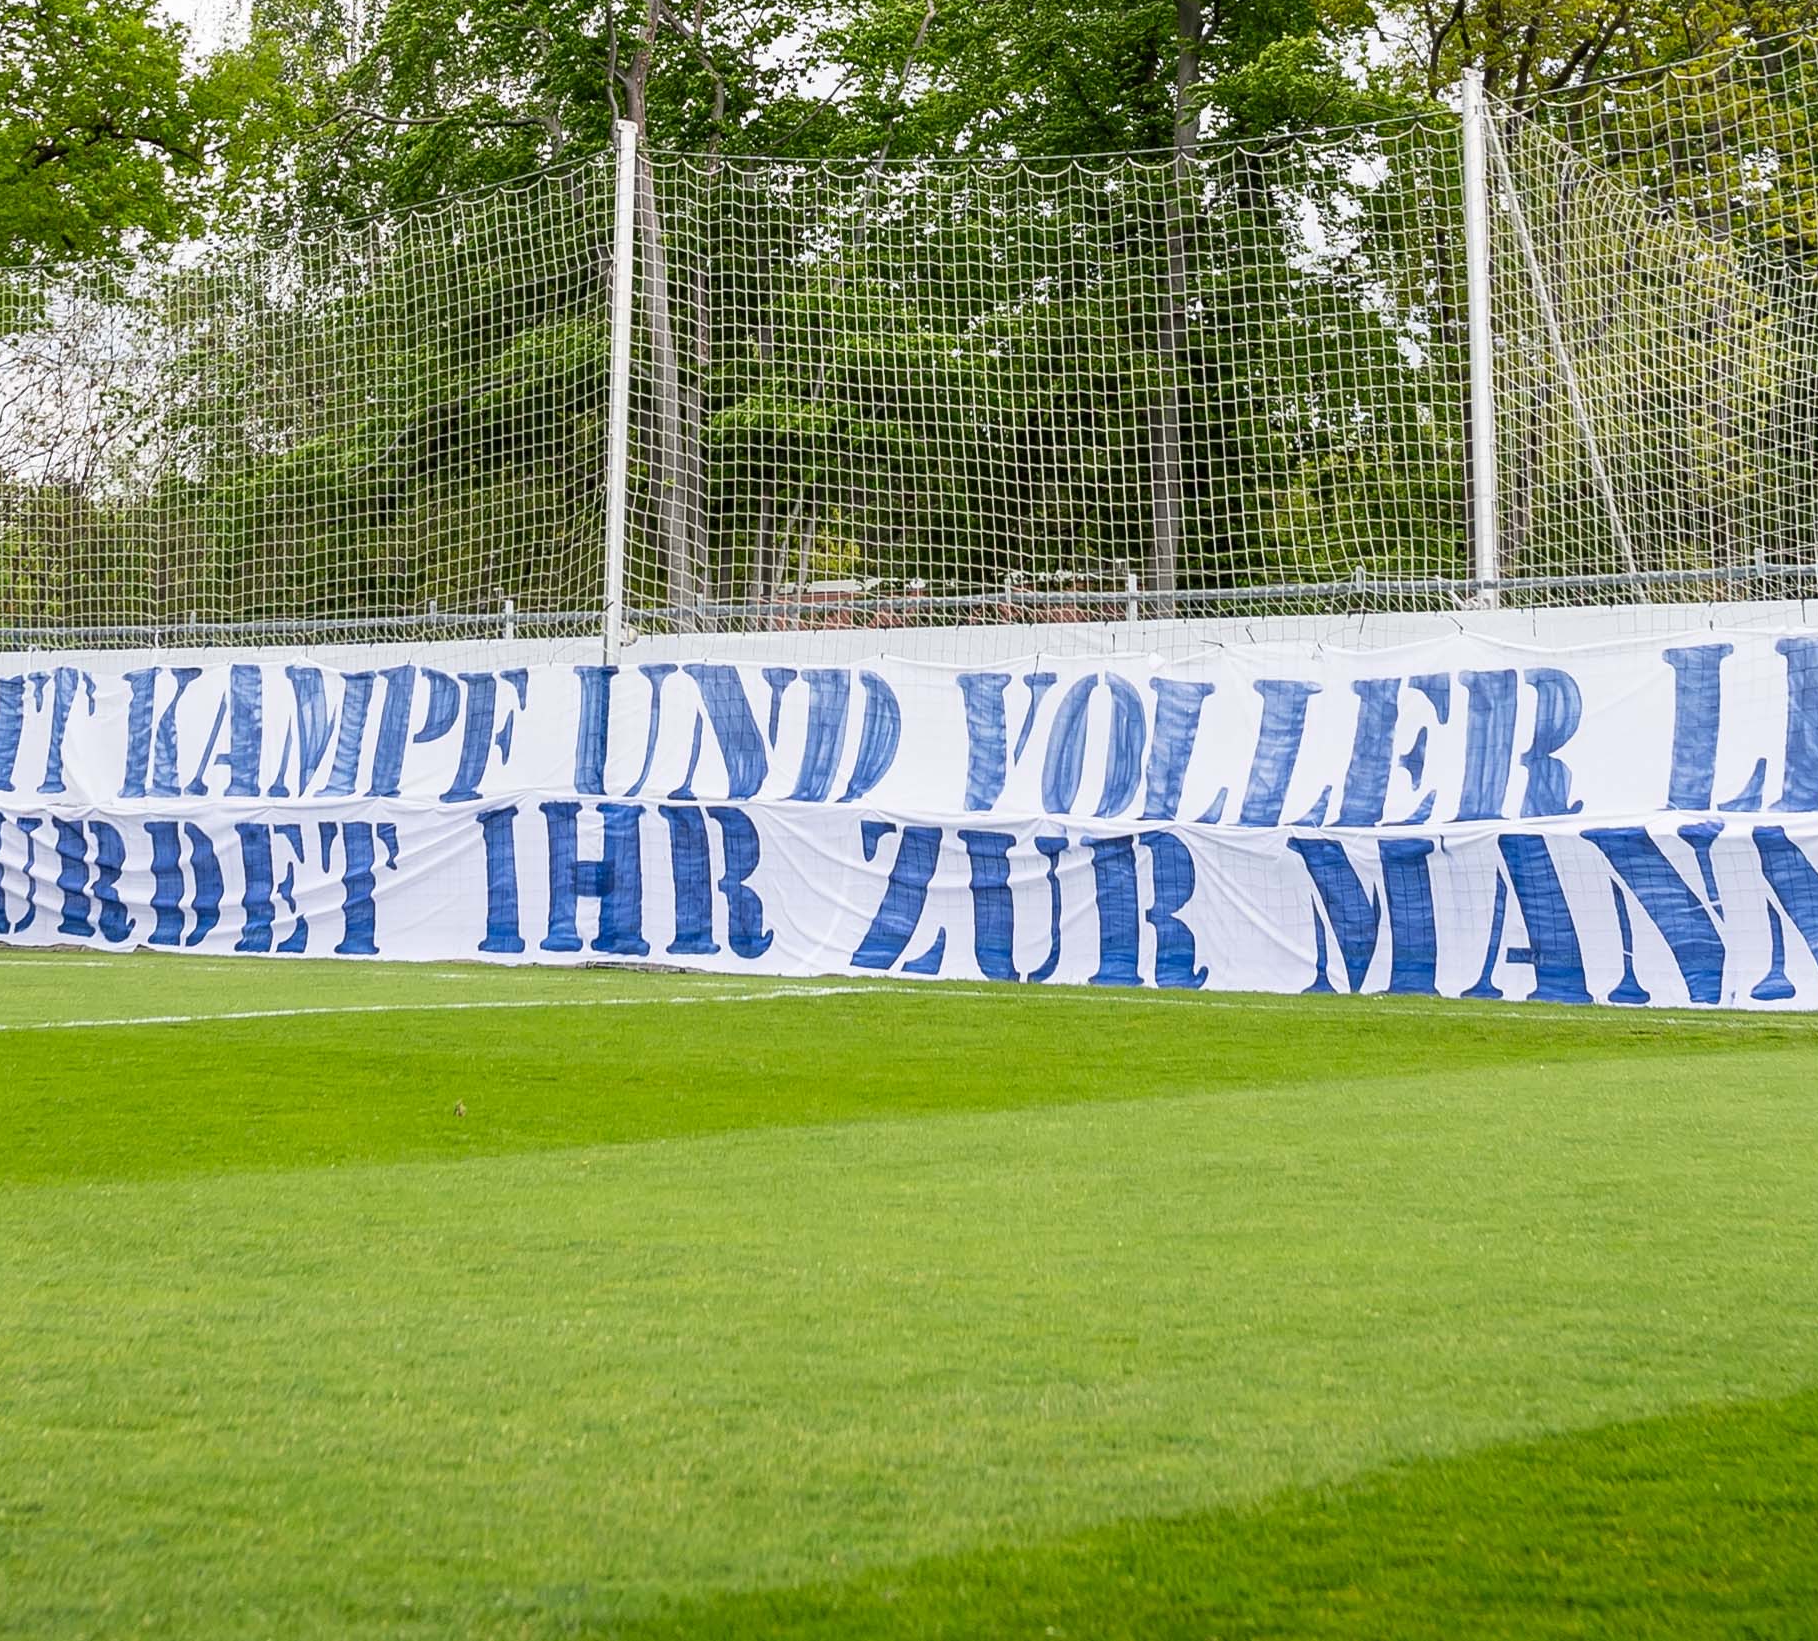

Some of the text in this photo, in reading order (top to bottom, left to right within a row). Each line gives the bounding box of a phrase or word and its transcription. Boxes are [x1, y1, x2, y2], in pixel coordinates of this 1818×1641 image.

[121, 663, 528, 803] KAMPF
[574, 663, 901, 802] UND
[957, 669, 1583, 823] VOLLER
[475, 801, 774, 960] IHR
[850, 818, 1209, 990] ZUR
